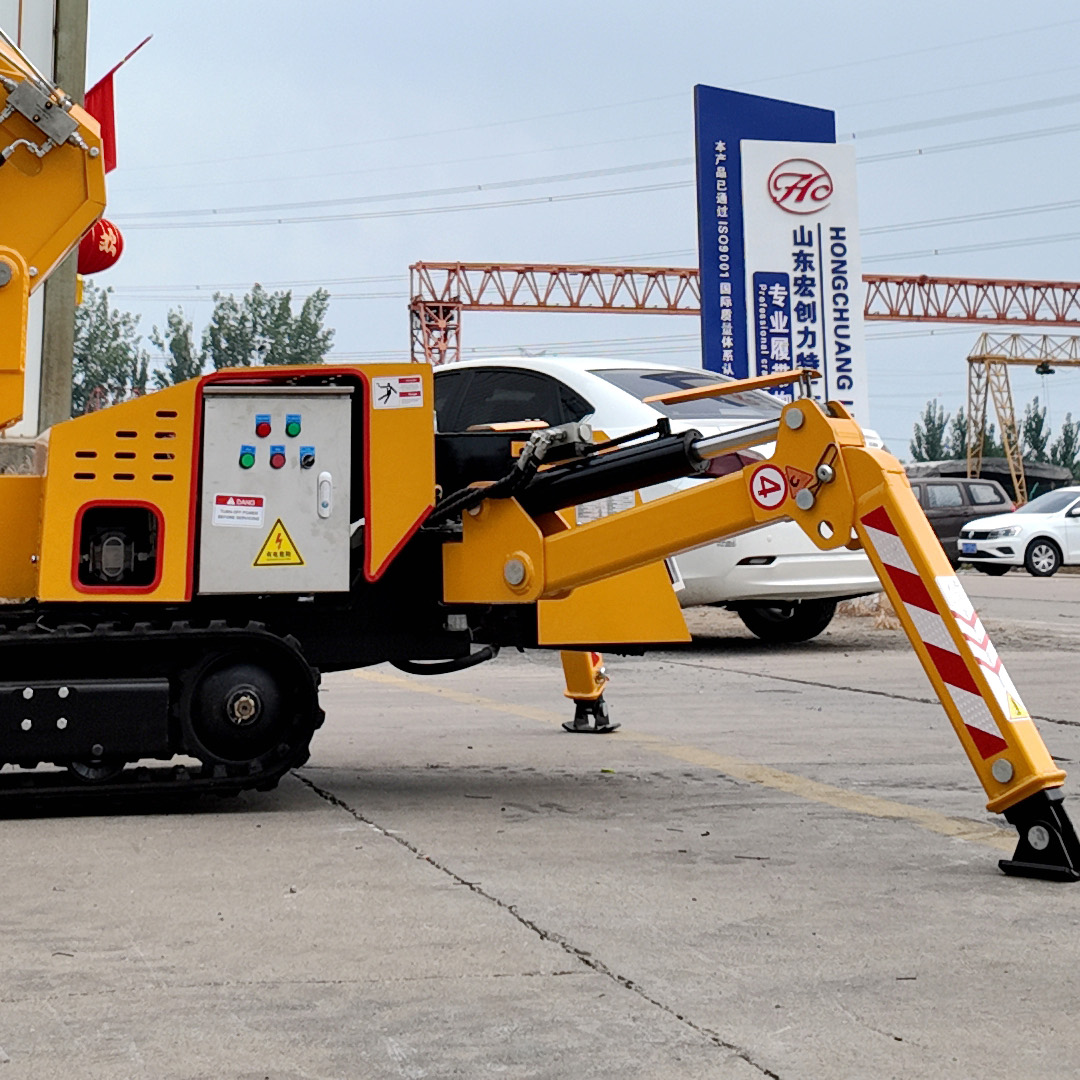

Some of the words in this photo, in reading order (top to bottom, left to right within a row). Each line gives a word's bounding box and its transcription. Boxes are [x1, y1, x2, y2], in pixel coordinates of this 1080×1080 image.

[792, 225, 820, 399] 山东宏创力特
[829, 226, 854, 391] HONGCHUANG
[757, 476, 782, 499] 4
